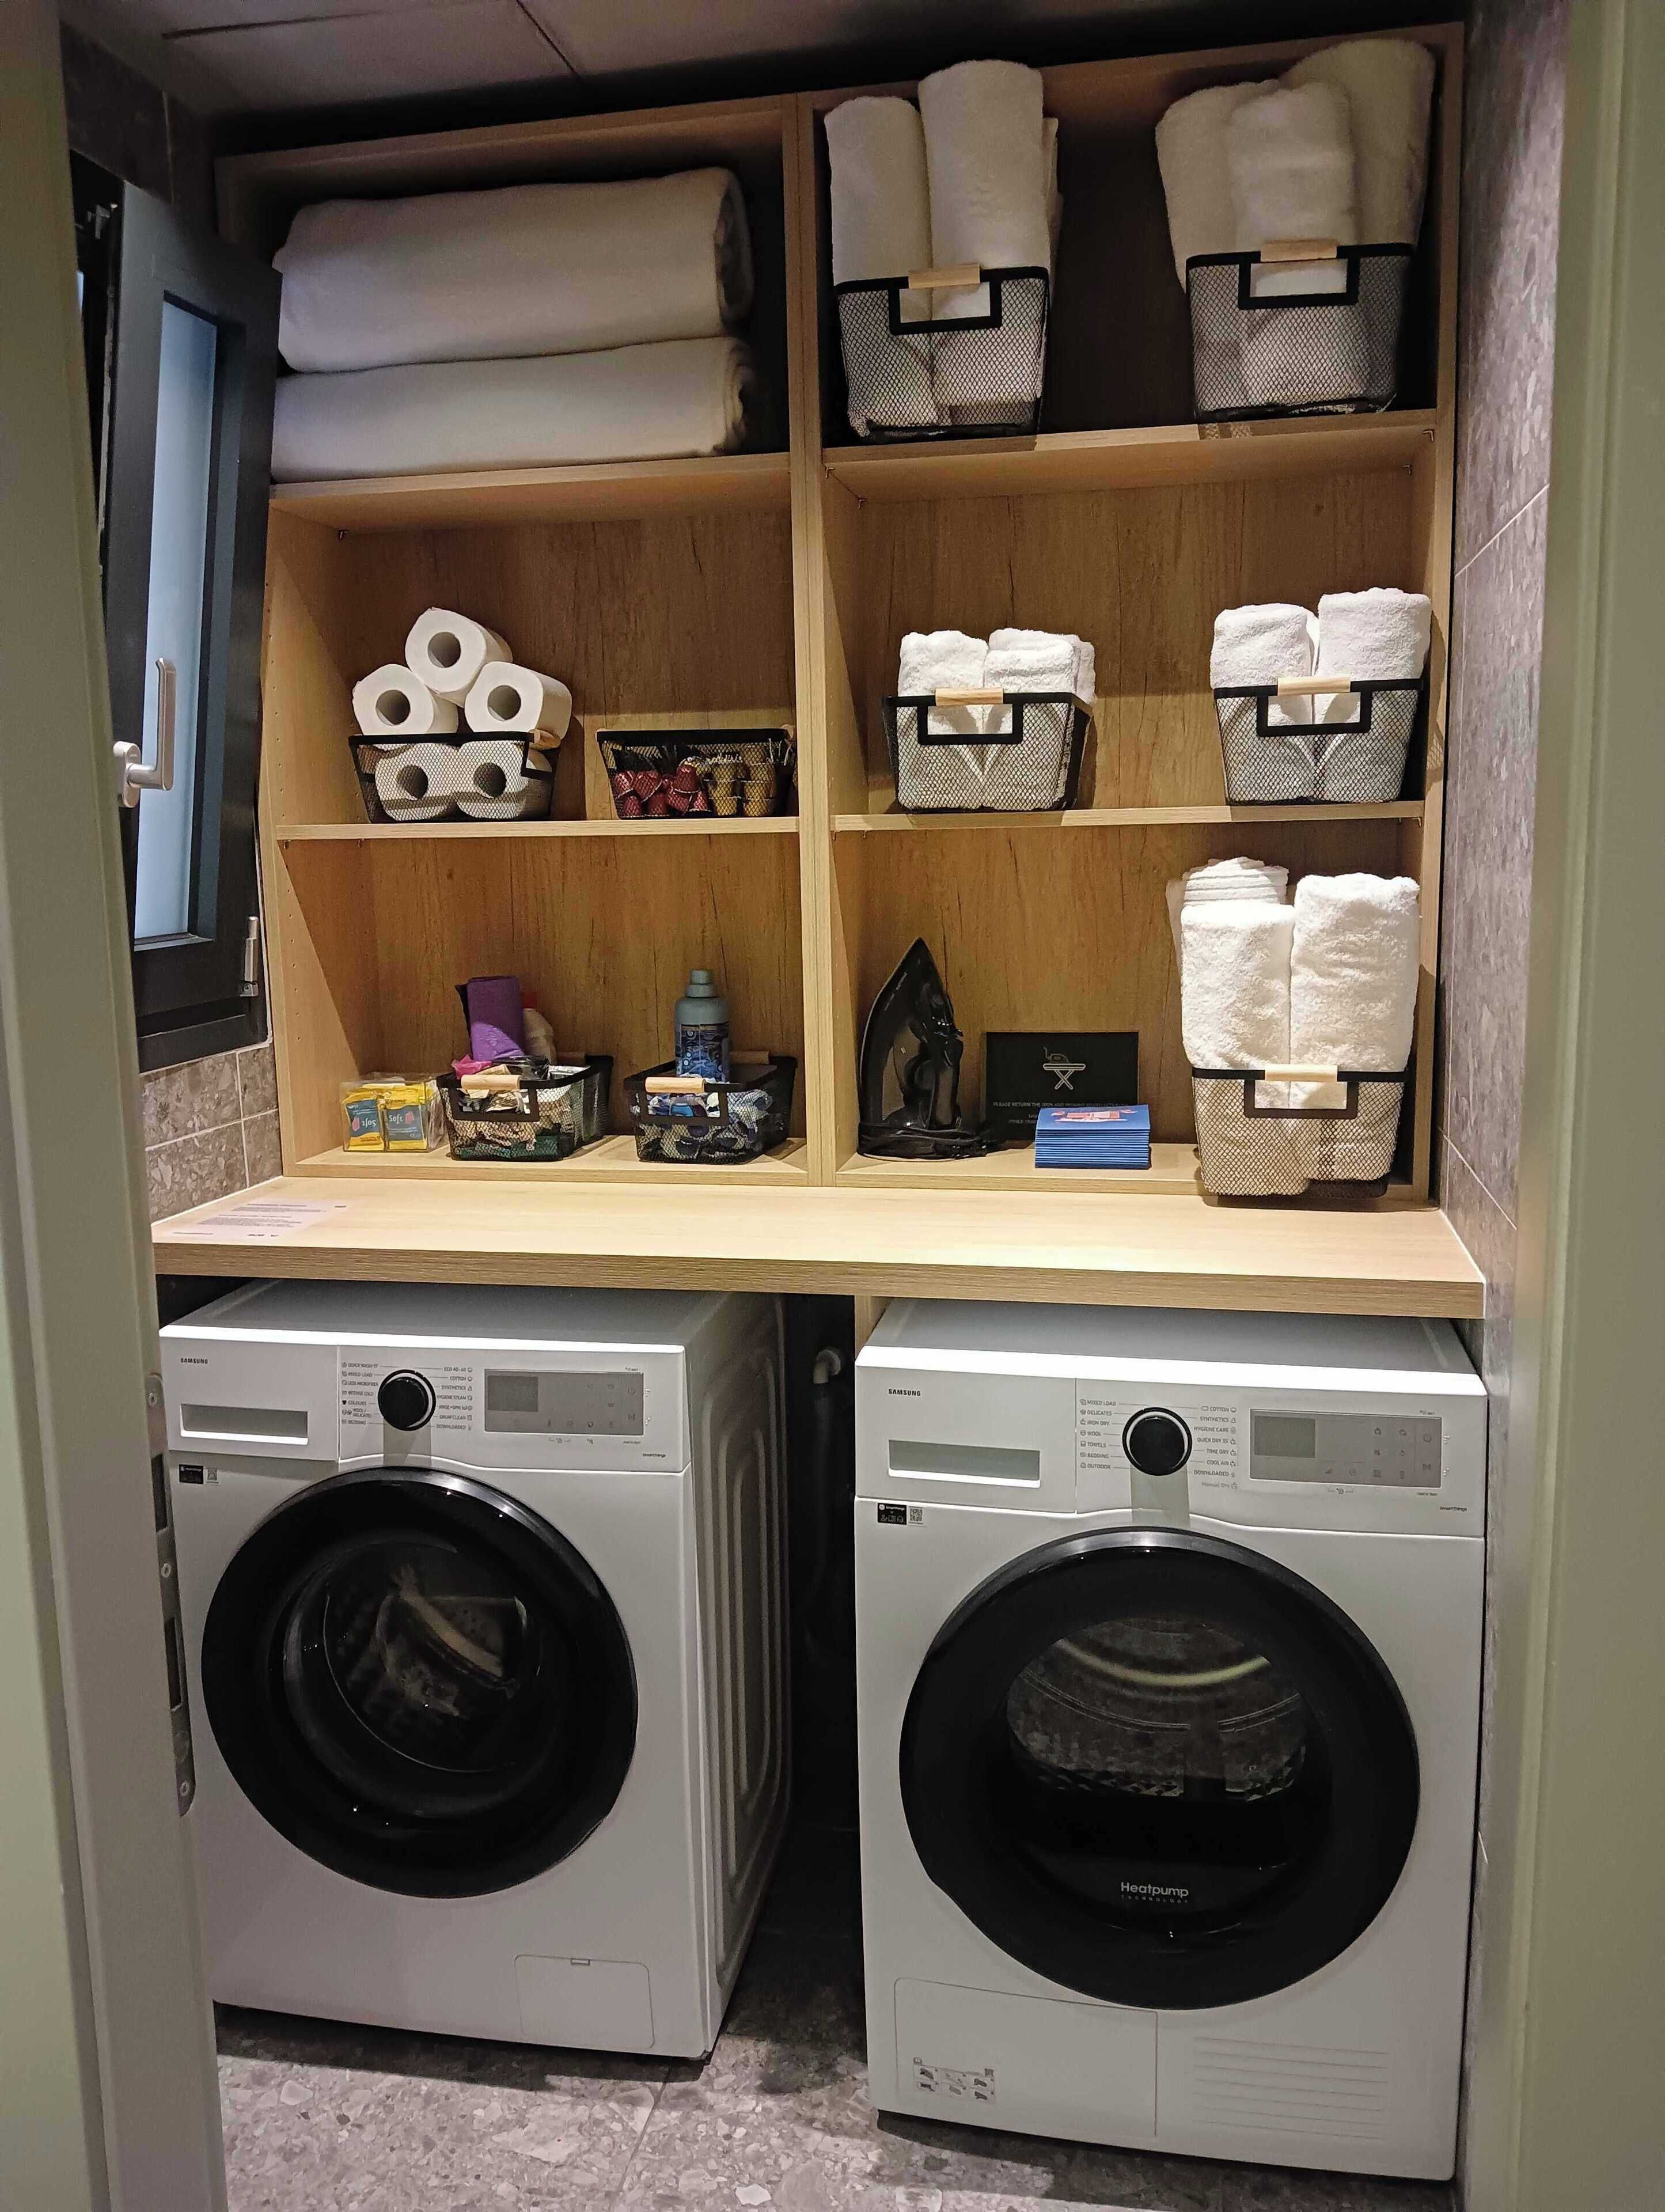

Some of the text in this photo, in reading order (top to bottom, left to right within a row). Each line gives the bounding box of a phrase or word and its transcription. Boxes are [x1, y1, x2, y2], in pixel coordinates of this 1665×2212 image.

[389, 1113, 403, 1124] Soft
[888, 1388, 921, 1396] SAMSUNG
[1121, 1881, 1189, 1898] Heatpump
